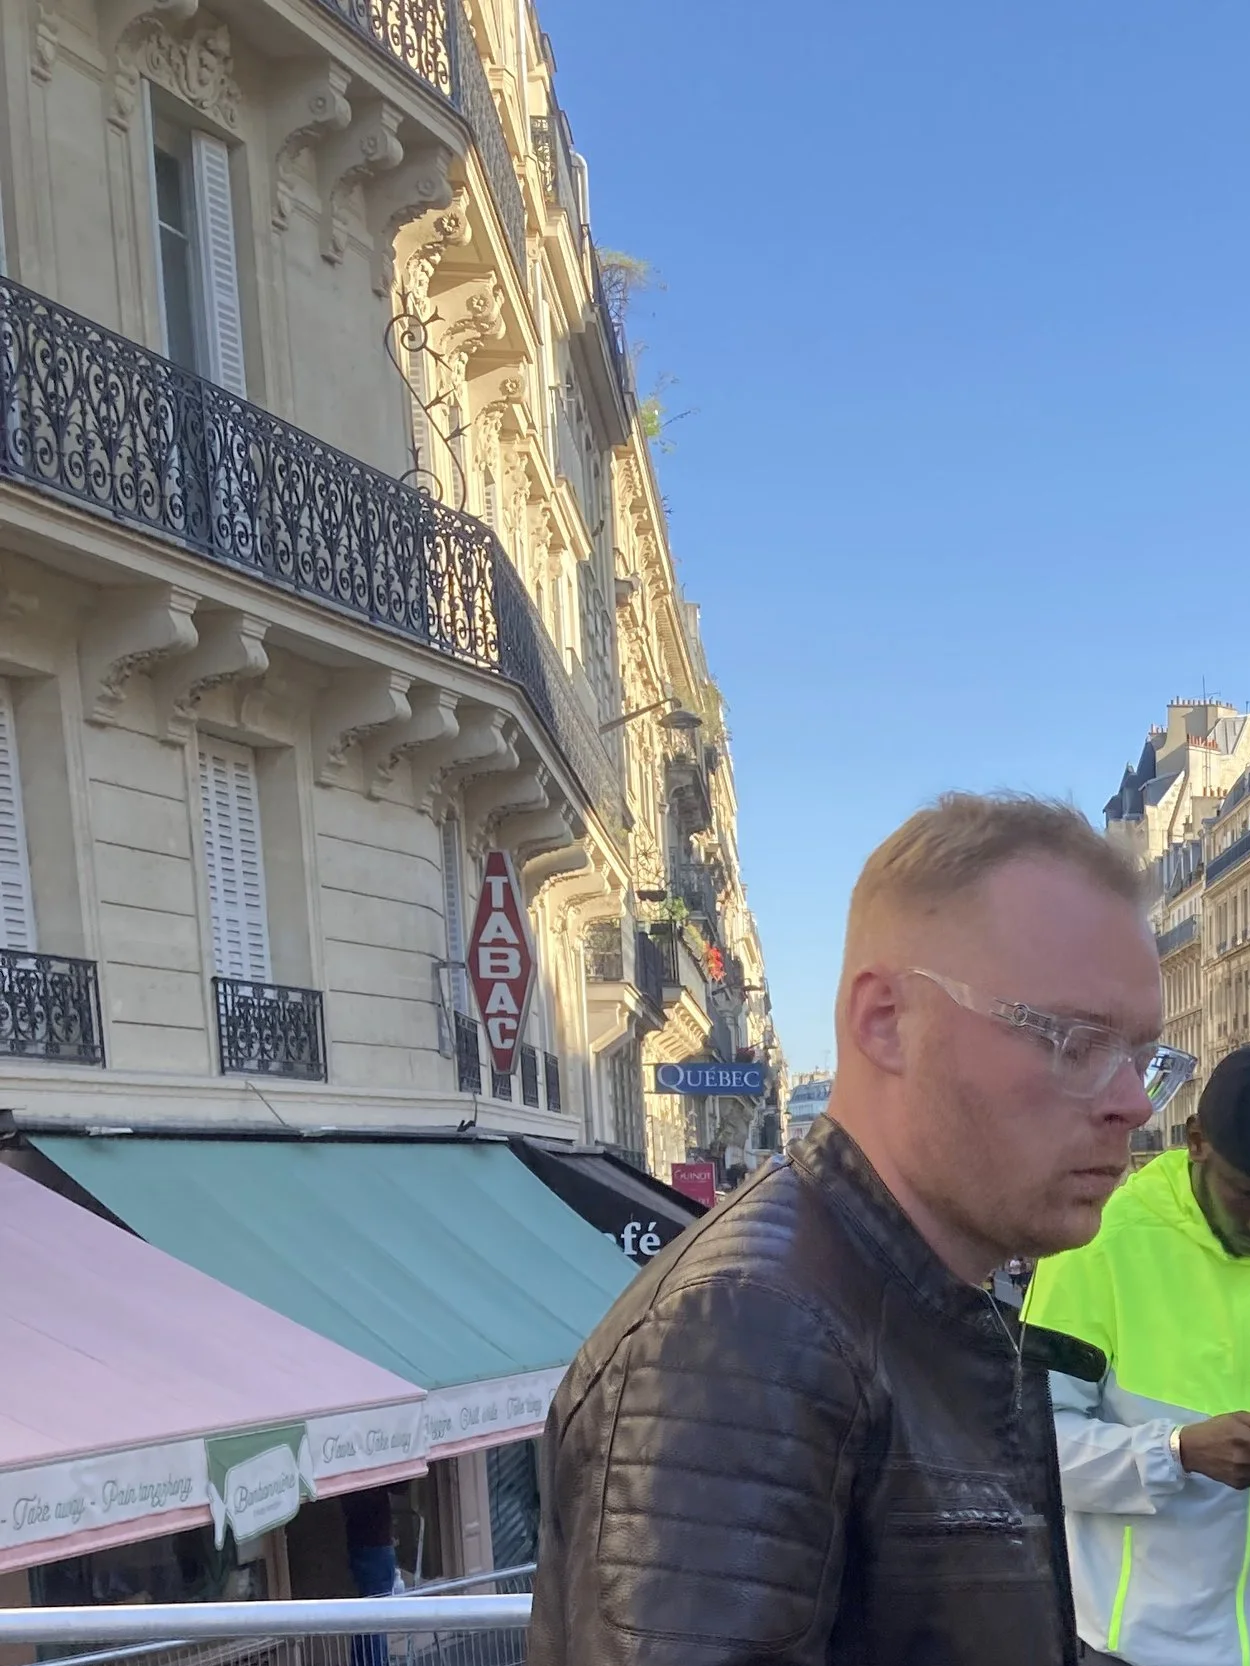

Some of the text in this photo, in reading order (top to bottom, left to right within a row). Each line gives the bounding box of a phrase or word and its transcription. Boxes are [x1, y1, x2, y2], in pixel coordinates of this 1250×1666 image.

[479, 876, 521, 1049] TABAC
[657, 1064, 760, 1093] QUÉBEC
[13, 1494, 51, 1531] Take
[54, 1496, 86, 1525] away
[102, 1479, 135, 1513] Pain
